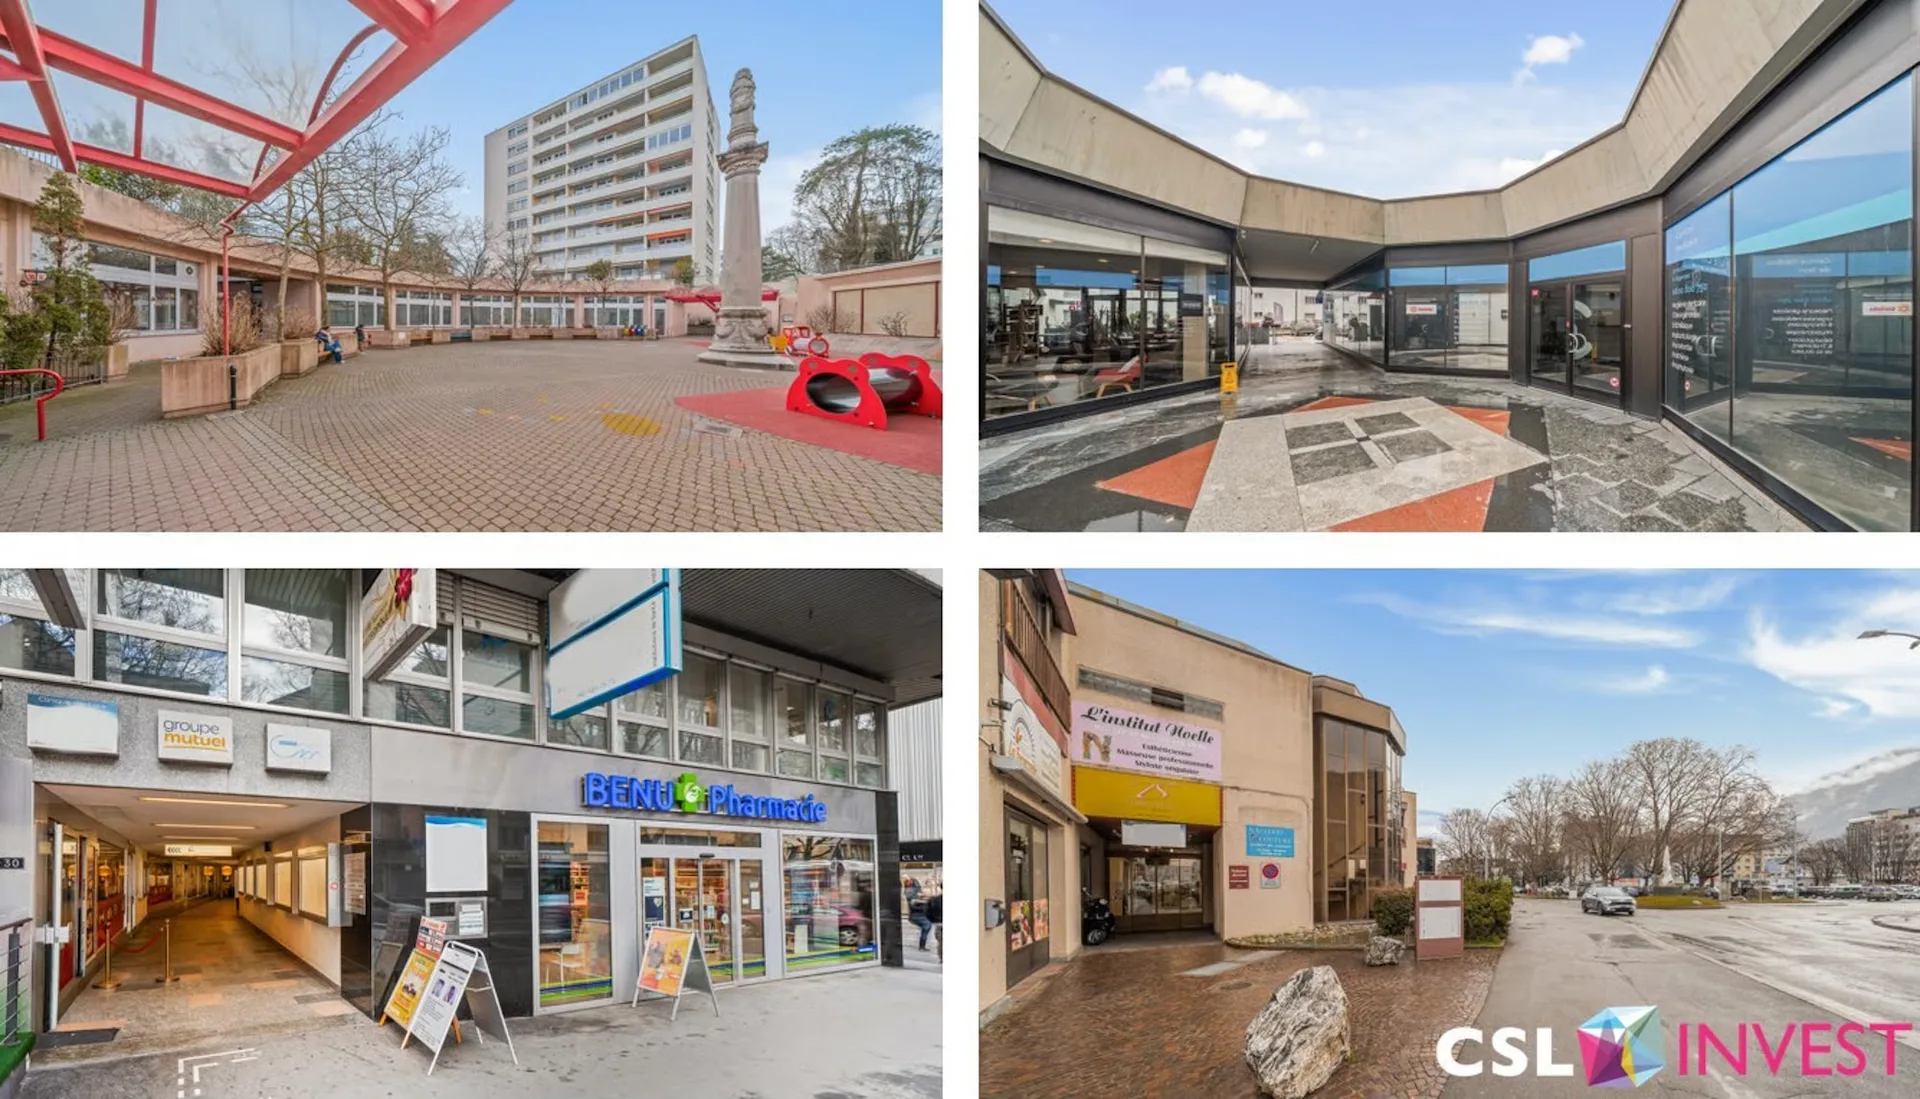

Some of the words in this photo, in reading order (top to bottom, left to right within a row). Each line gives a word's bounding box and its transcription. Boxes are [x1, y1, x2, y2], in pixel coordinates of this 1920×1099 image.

[163, 720, 219, 735] groupe
[1081, 706, 1160, 733] L'institut
[1165, 723, 1214, 744] Noelle
[164, 733, 226, 748] mutuel
[1117, 748, 1157, 760] Masseuse
[583, 772, 675, 811] BENU
[709, 785, 828, 823] Pharmacie
[4, 858, 20, 869] 30
